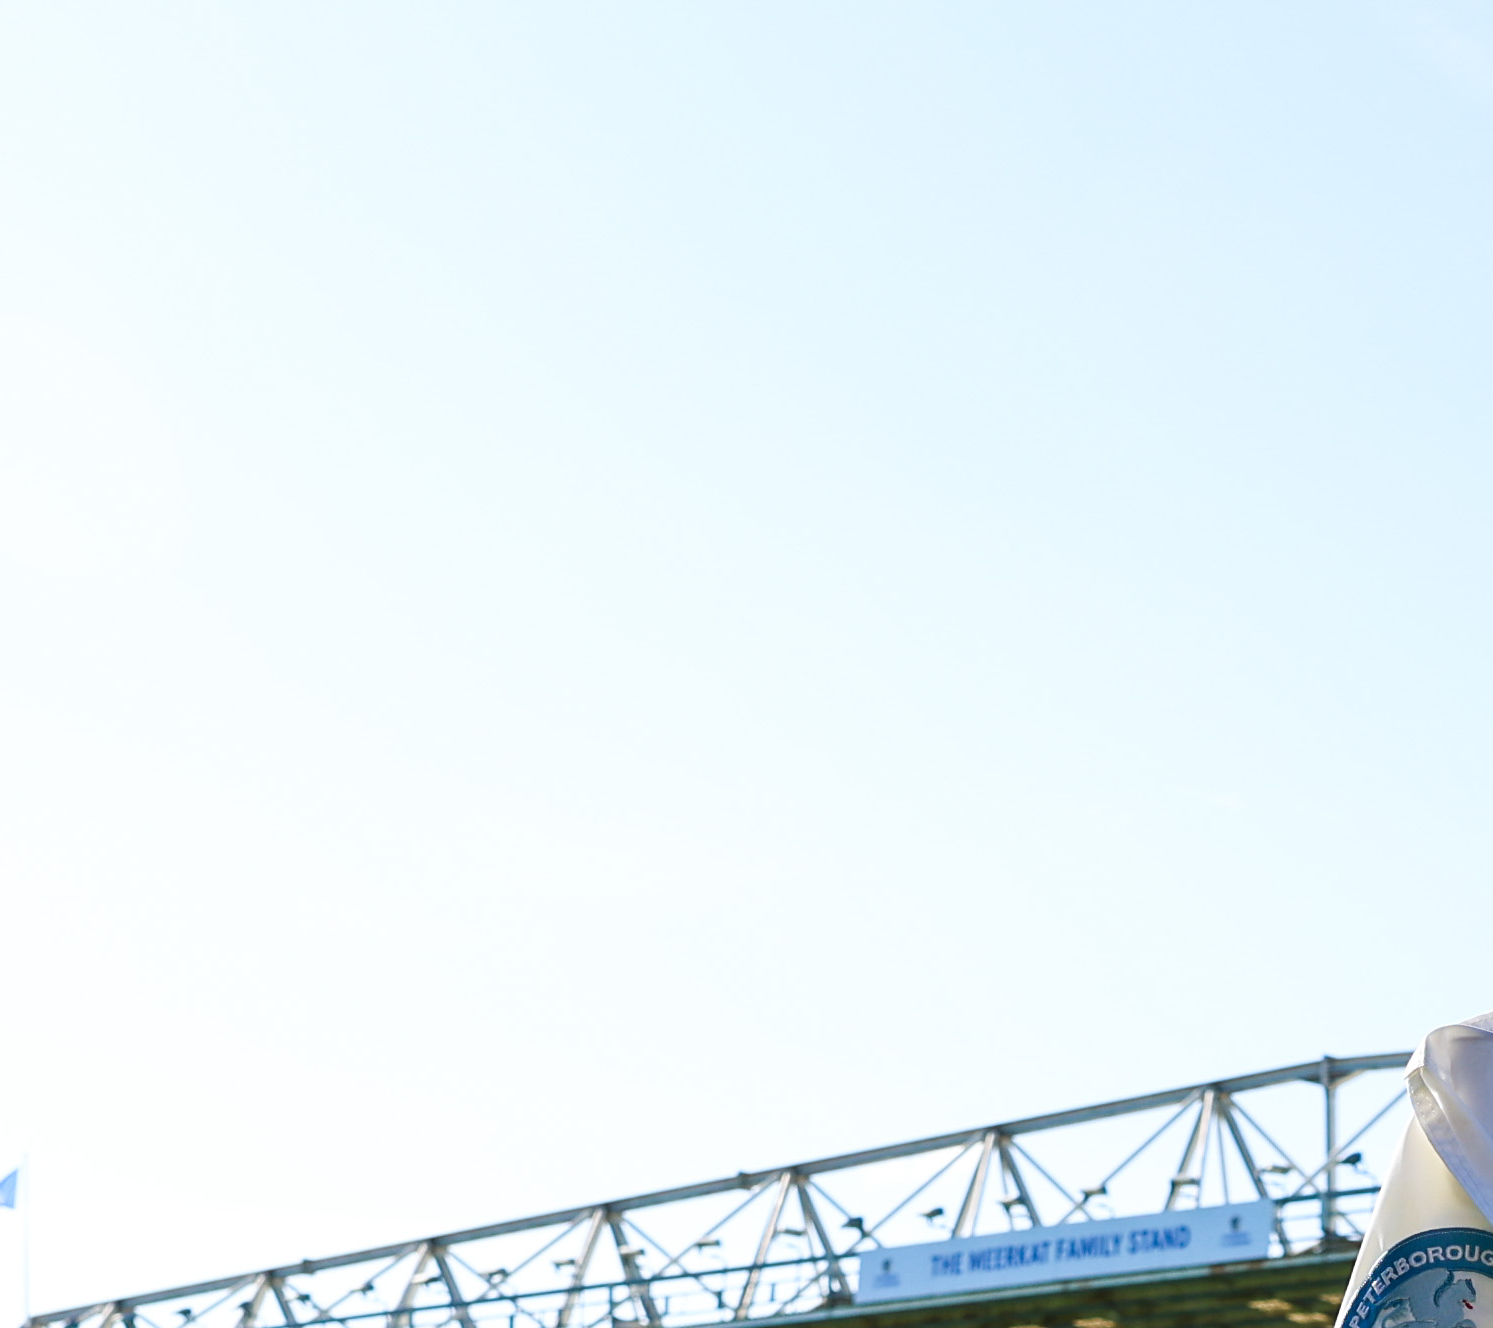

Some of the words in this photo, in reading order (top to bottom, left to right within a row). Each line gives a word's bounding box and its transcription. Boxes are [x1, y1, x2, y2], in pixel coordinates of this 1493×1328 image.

[932, 1252, 963, 1277] THE
[969, 1241, 1051, 1273] MEERKAT
[1054, 1232, 1121, 1264] FAMILY
[1127, 1225, 1191, 1255] STAND
